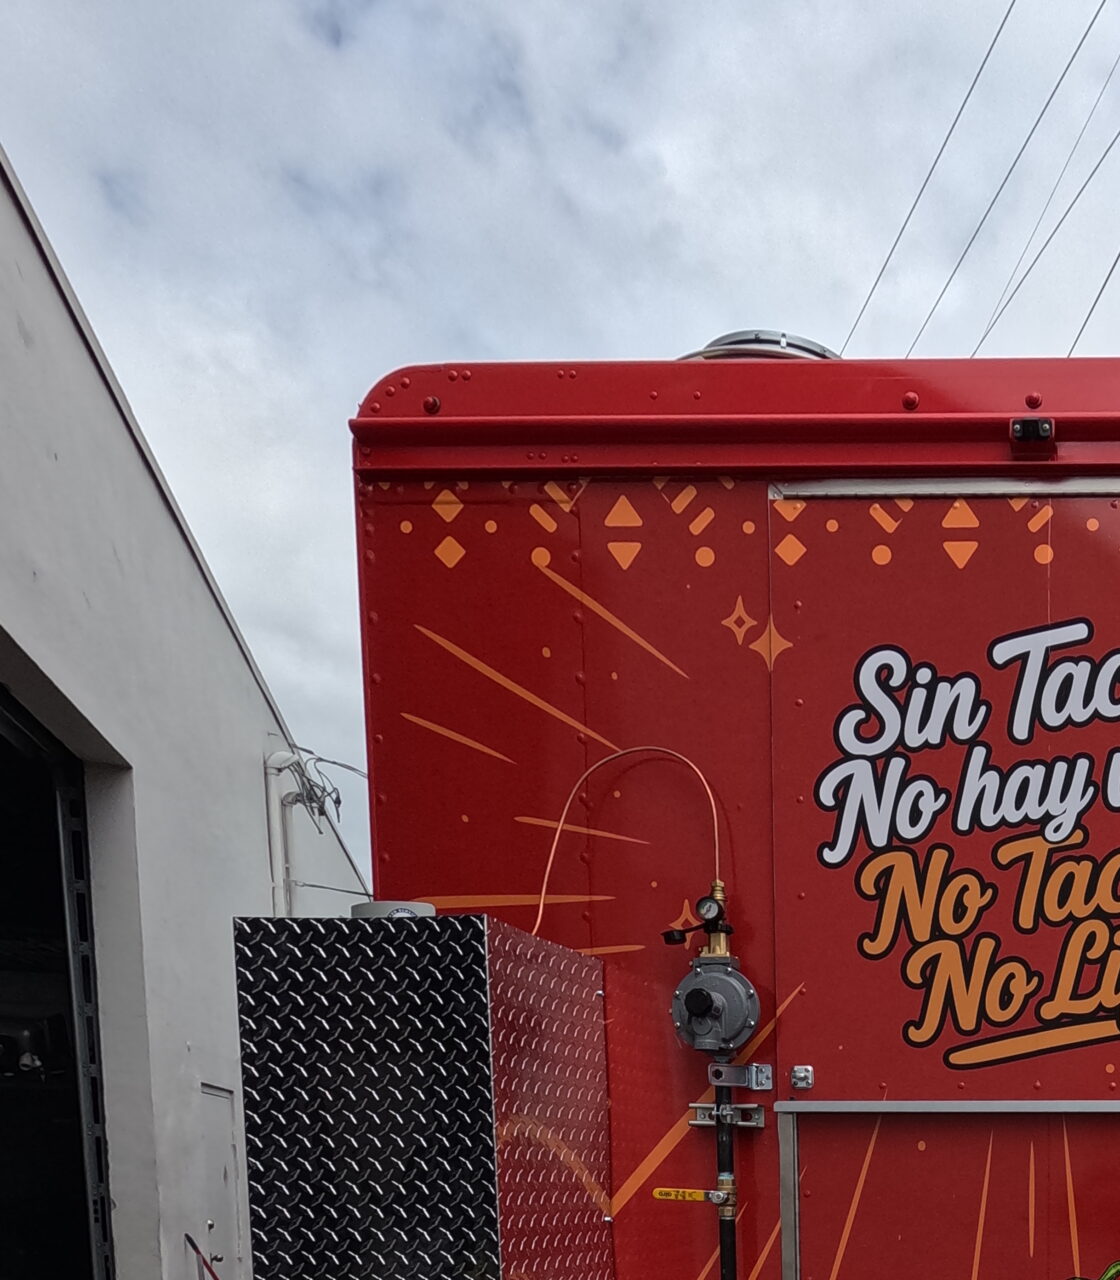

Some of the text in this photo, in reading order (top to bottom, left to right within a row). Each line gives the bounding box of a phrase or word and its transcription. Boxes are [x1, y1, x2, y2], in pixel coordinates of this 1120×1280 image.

[837, 648, 987, 757] Sin
[818, 755, 948, 864] No
[955, 744, 1095, 842] hay
[859, 847, 994, 956] No
[905, 937, 1039, 1044] No
